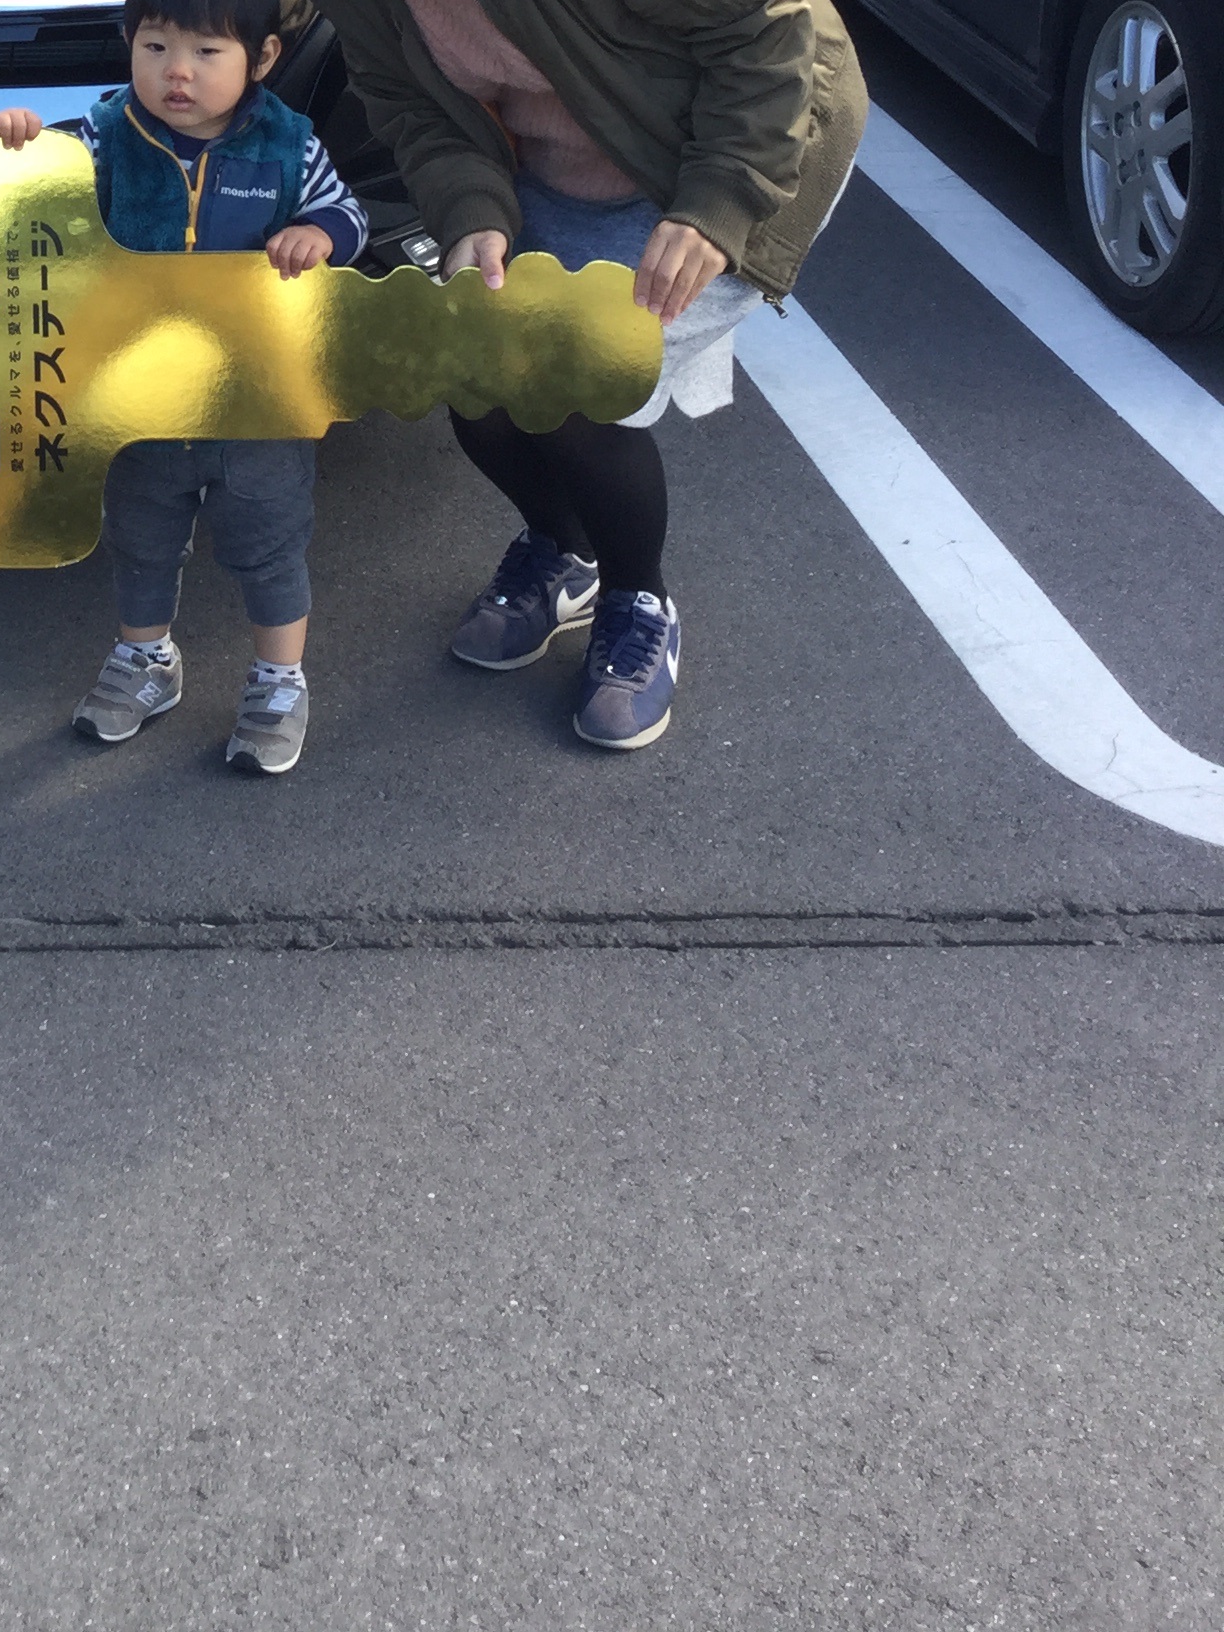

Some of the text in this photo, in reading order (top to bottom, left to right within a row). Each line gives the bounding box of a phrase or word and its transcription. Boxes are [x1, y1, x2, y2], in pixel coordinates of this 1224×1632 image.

[31, 220, 68, 473] ネクステージ
